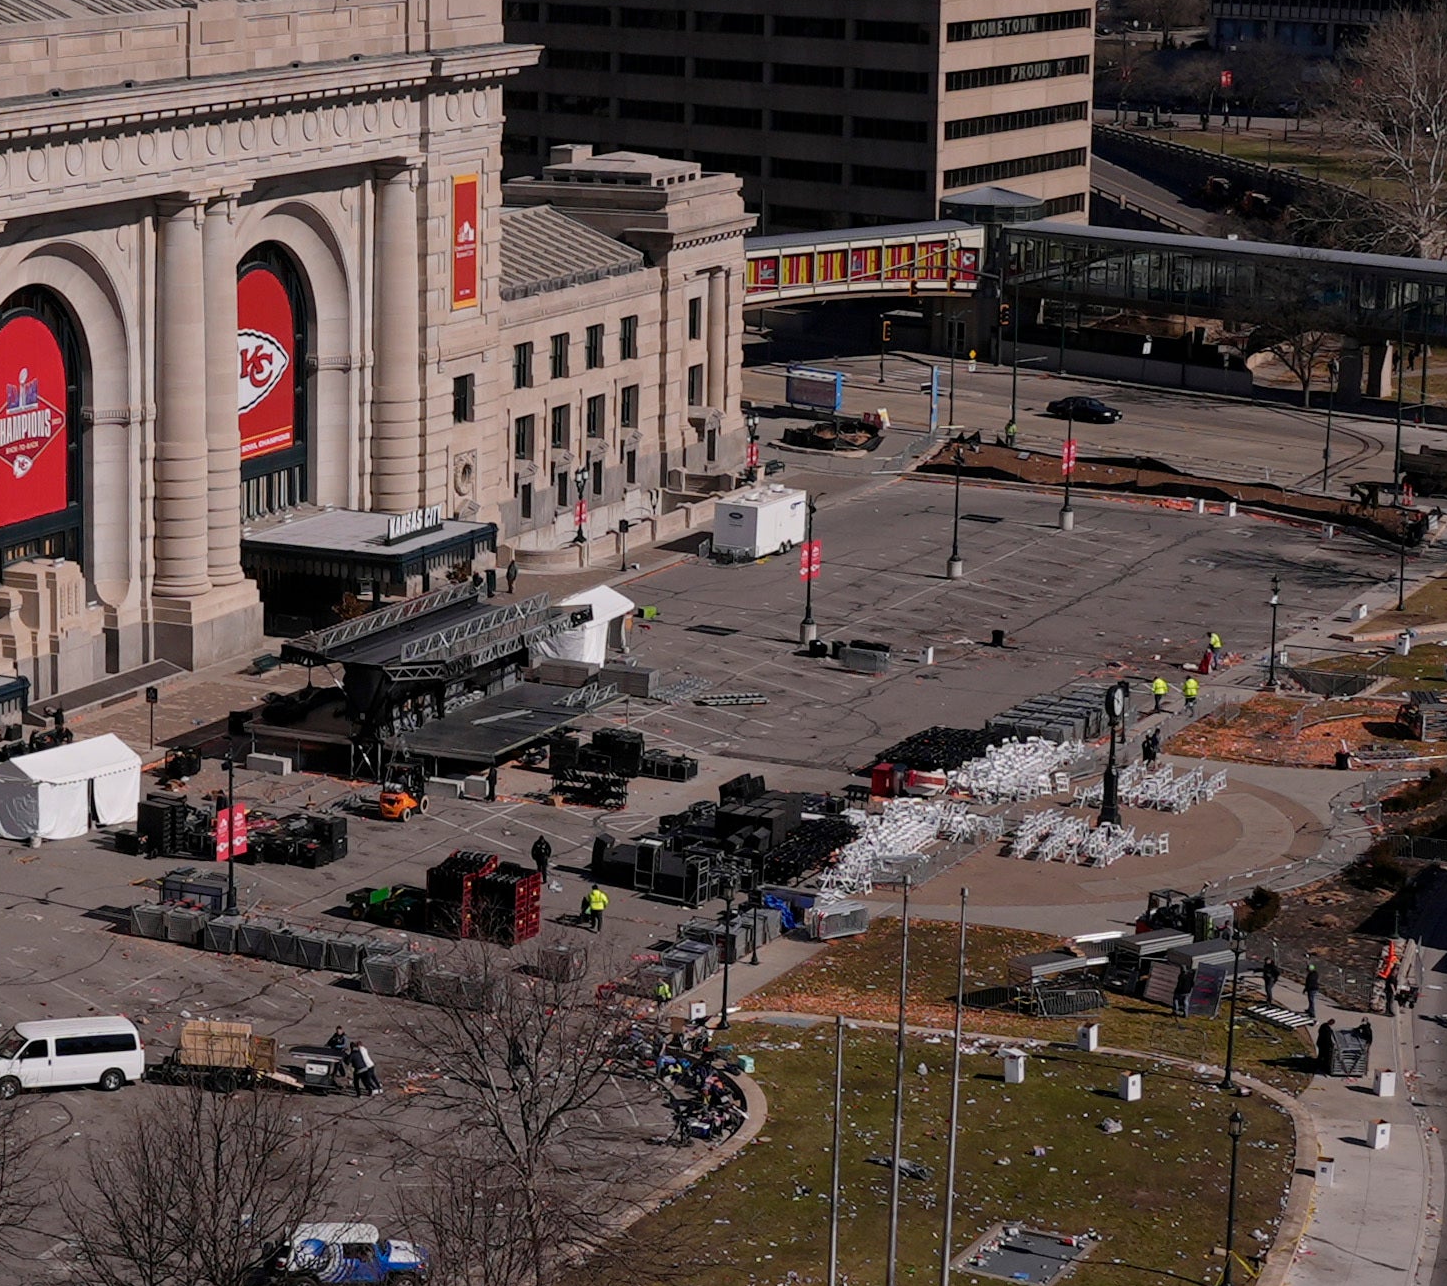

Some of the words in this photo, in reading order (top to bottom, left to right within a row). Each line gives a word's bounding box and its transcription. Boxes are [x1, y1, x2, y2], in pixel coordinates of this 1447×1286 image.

[971, 17, 1036, 37] HOMETOWN
[1010, 62, 1050, 81] PROUD
[240, 344, 274, 388] KC
[389, 508, 423, 540] KANSAS
[424, 503, 443, 529] CITY
